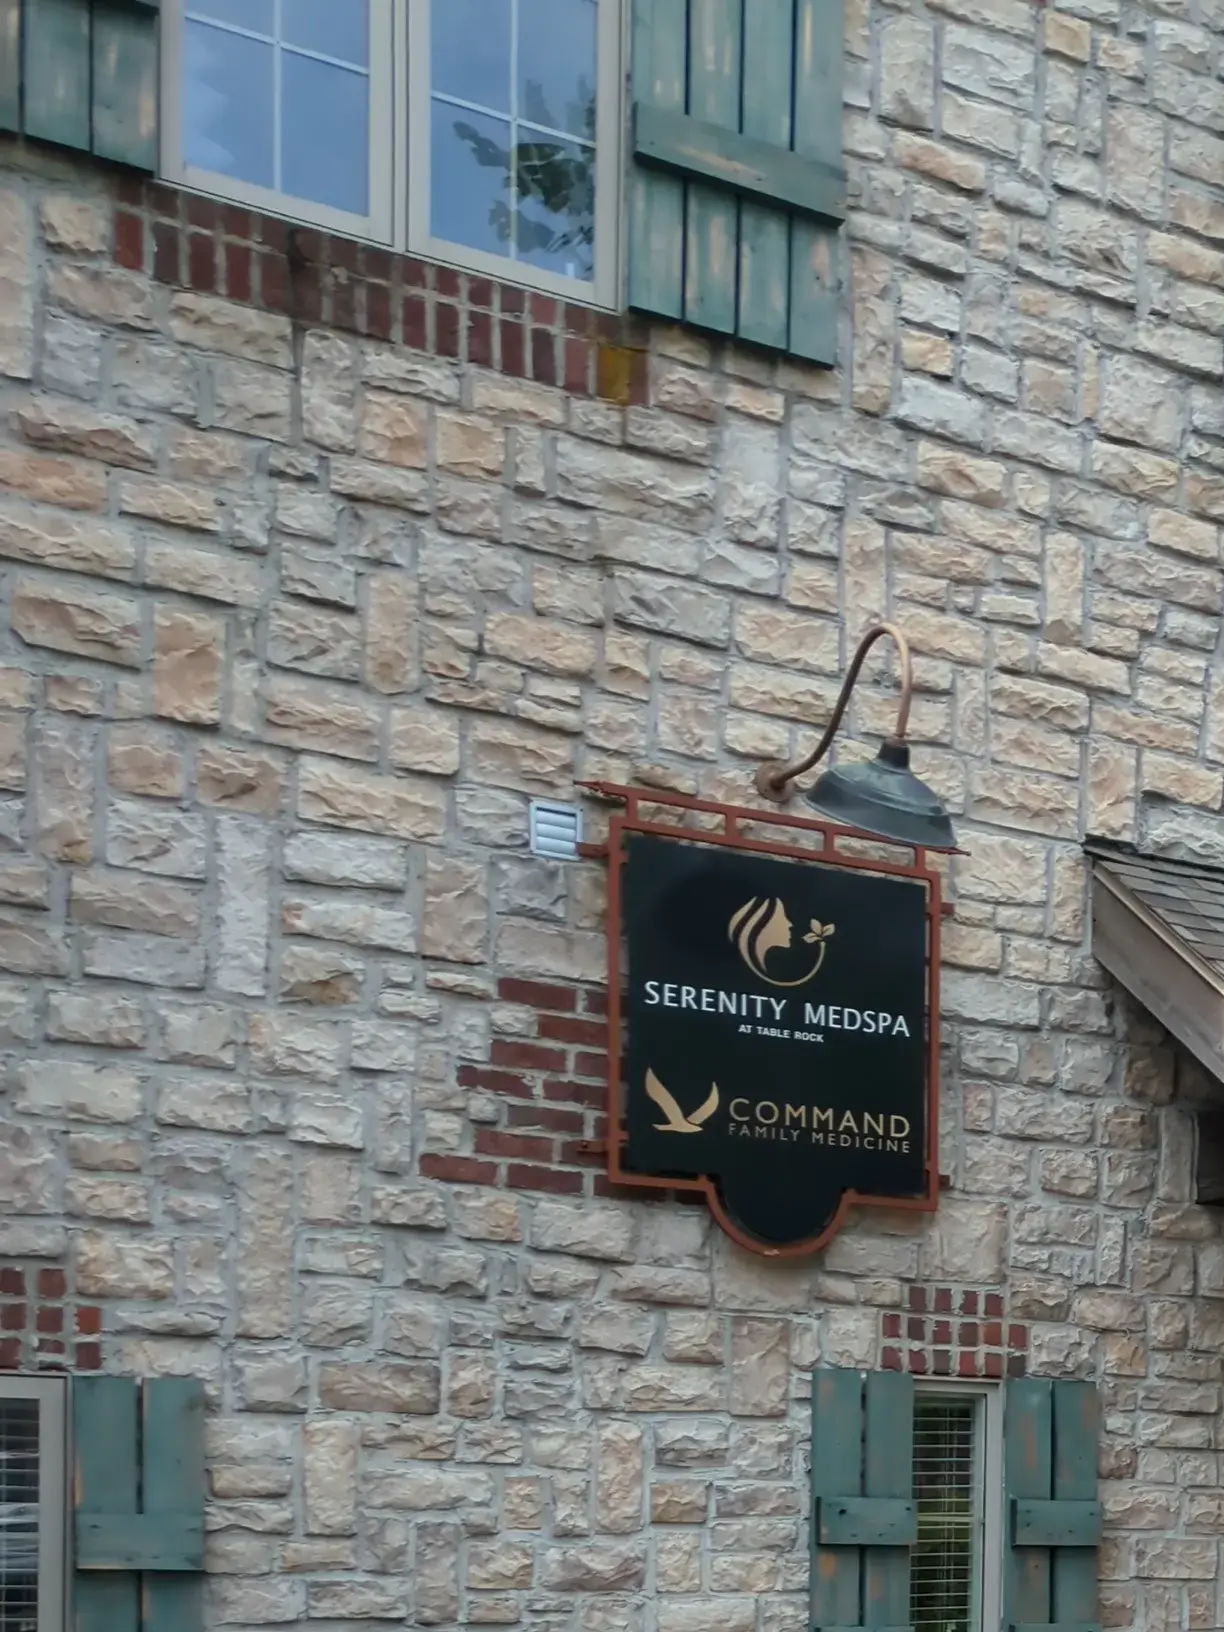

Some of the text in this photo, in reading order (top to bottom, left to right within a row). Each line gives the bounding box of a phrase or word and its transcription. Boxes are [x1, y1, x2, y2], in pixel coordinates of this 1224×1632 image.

[644, 980, 911, 1038] SERENITY MEDSPA
[738, 1024, 824, 1043] AT TABLE ROCK
[729, 1098, 910, 1138] COMMAND
[728, 1123, 911, 1154] FAMILY MEDICINE
